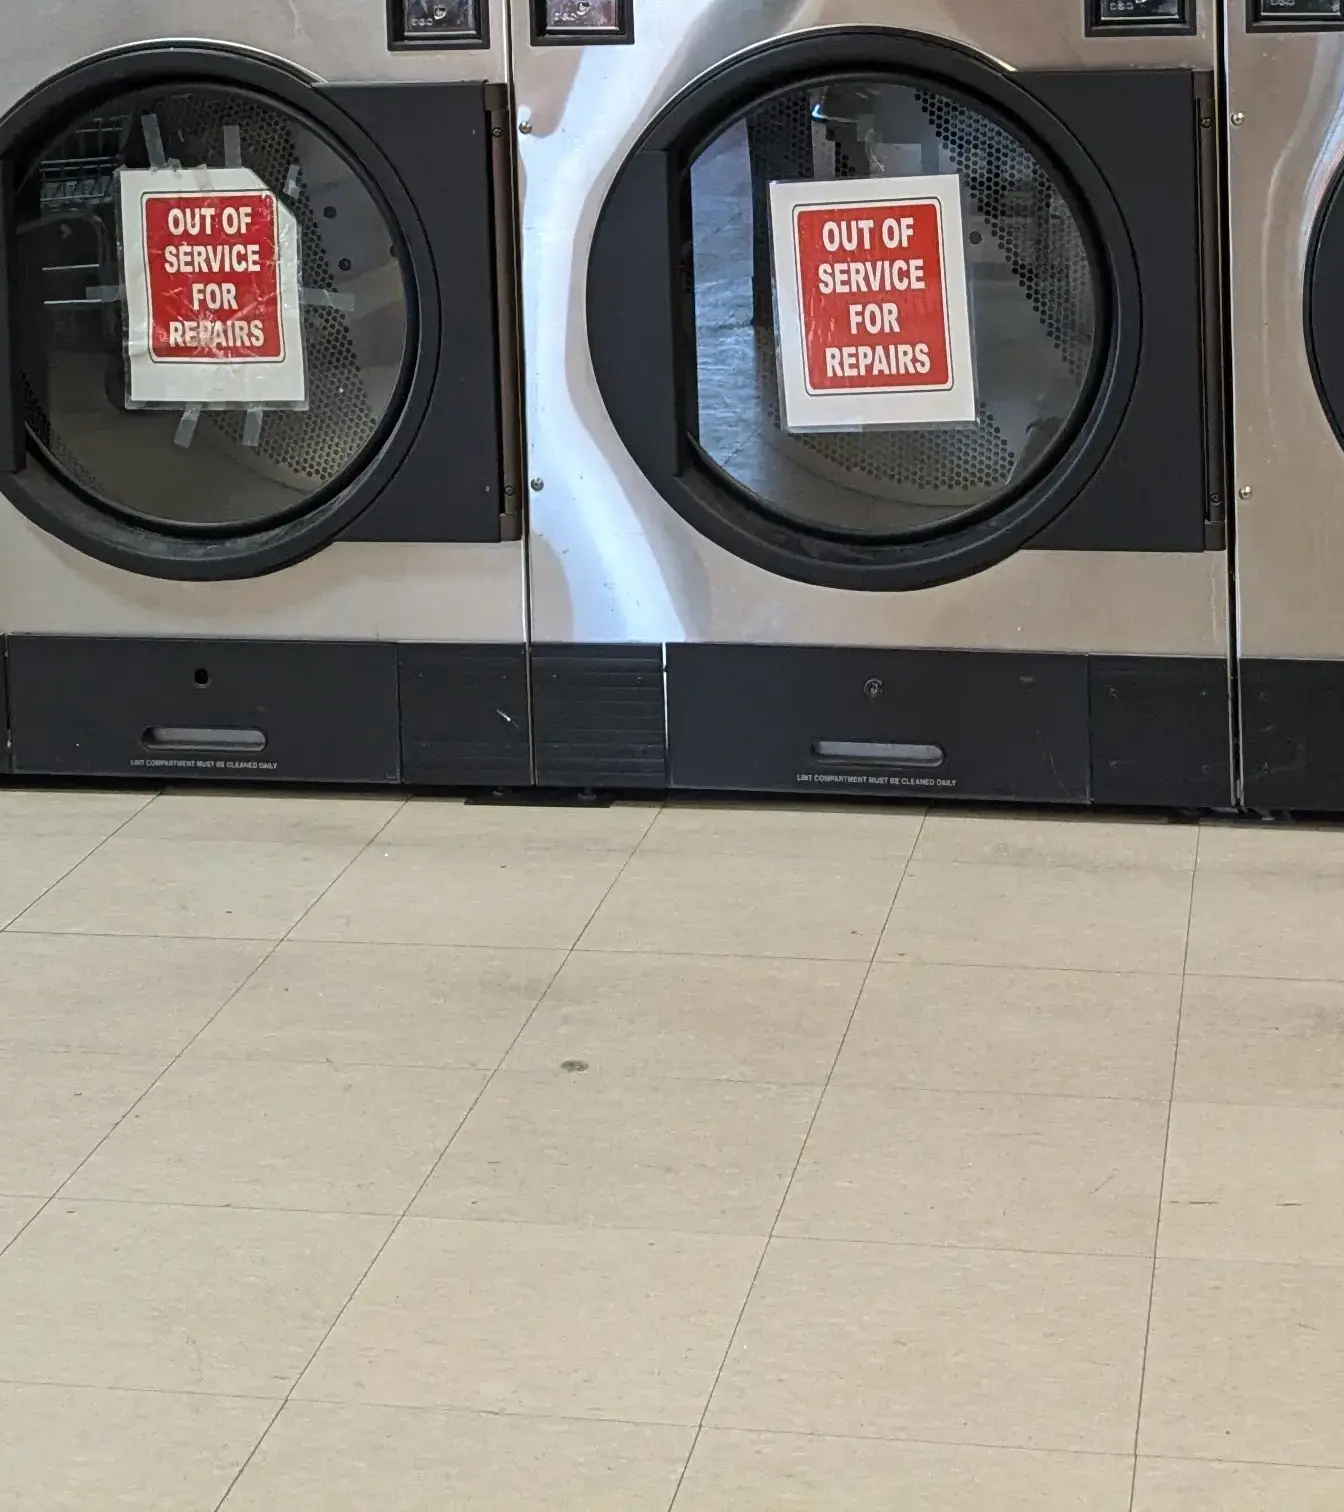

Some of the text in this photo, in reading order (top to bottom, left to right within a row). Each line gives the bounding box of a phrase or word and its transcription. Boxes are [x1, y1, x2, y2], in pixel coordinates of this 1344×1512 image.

[168, 207, 251, 236] OUT OF
[823, 217, 913, 251] OUT OF
[164, 245, 260, 273] SERVICE
[818, 259, 925, 294] SERVICE
[192, 283, 237, 310] FOR
[849, 303, 900, 334] FOR
[169, 320, 264, 348] REPAIRS
[825, 343, 930, 377] REPAIRS
[814, 775, 867, 783] COMPARTMENT
